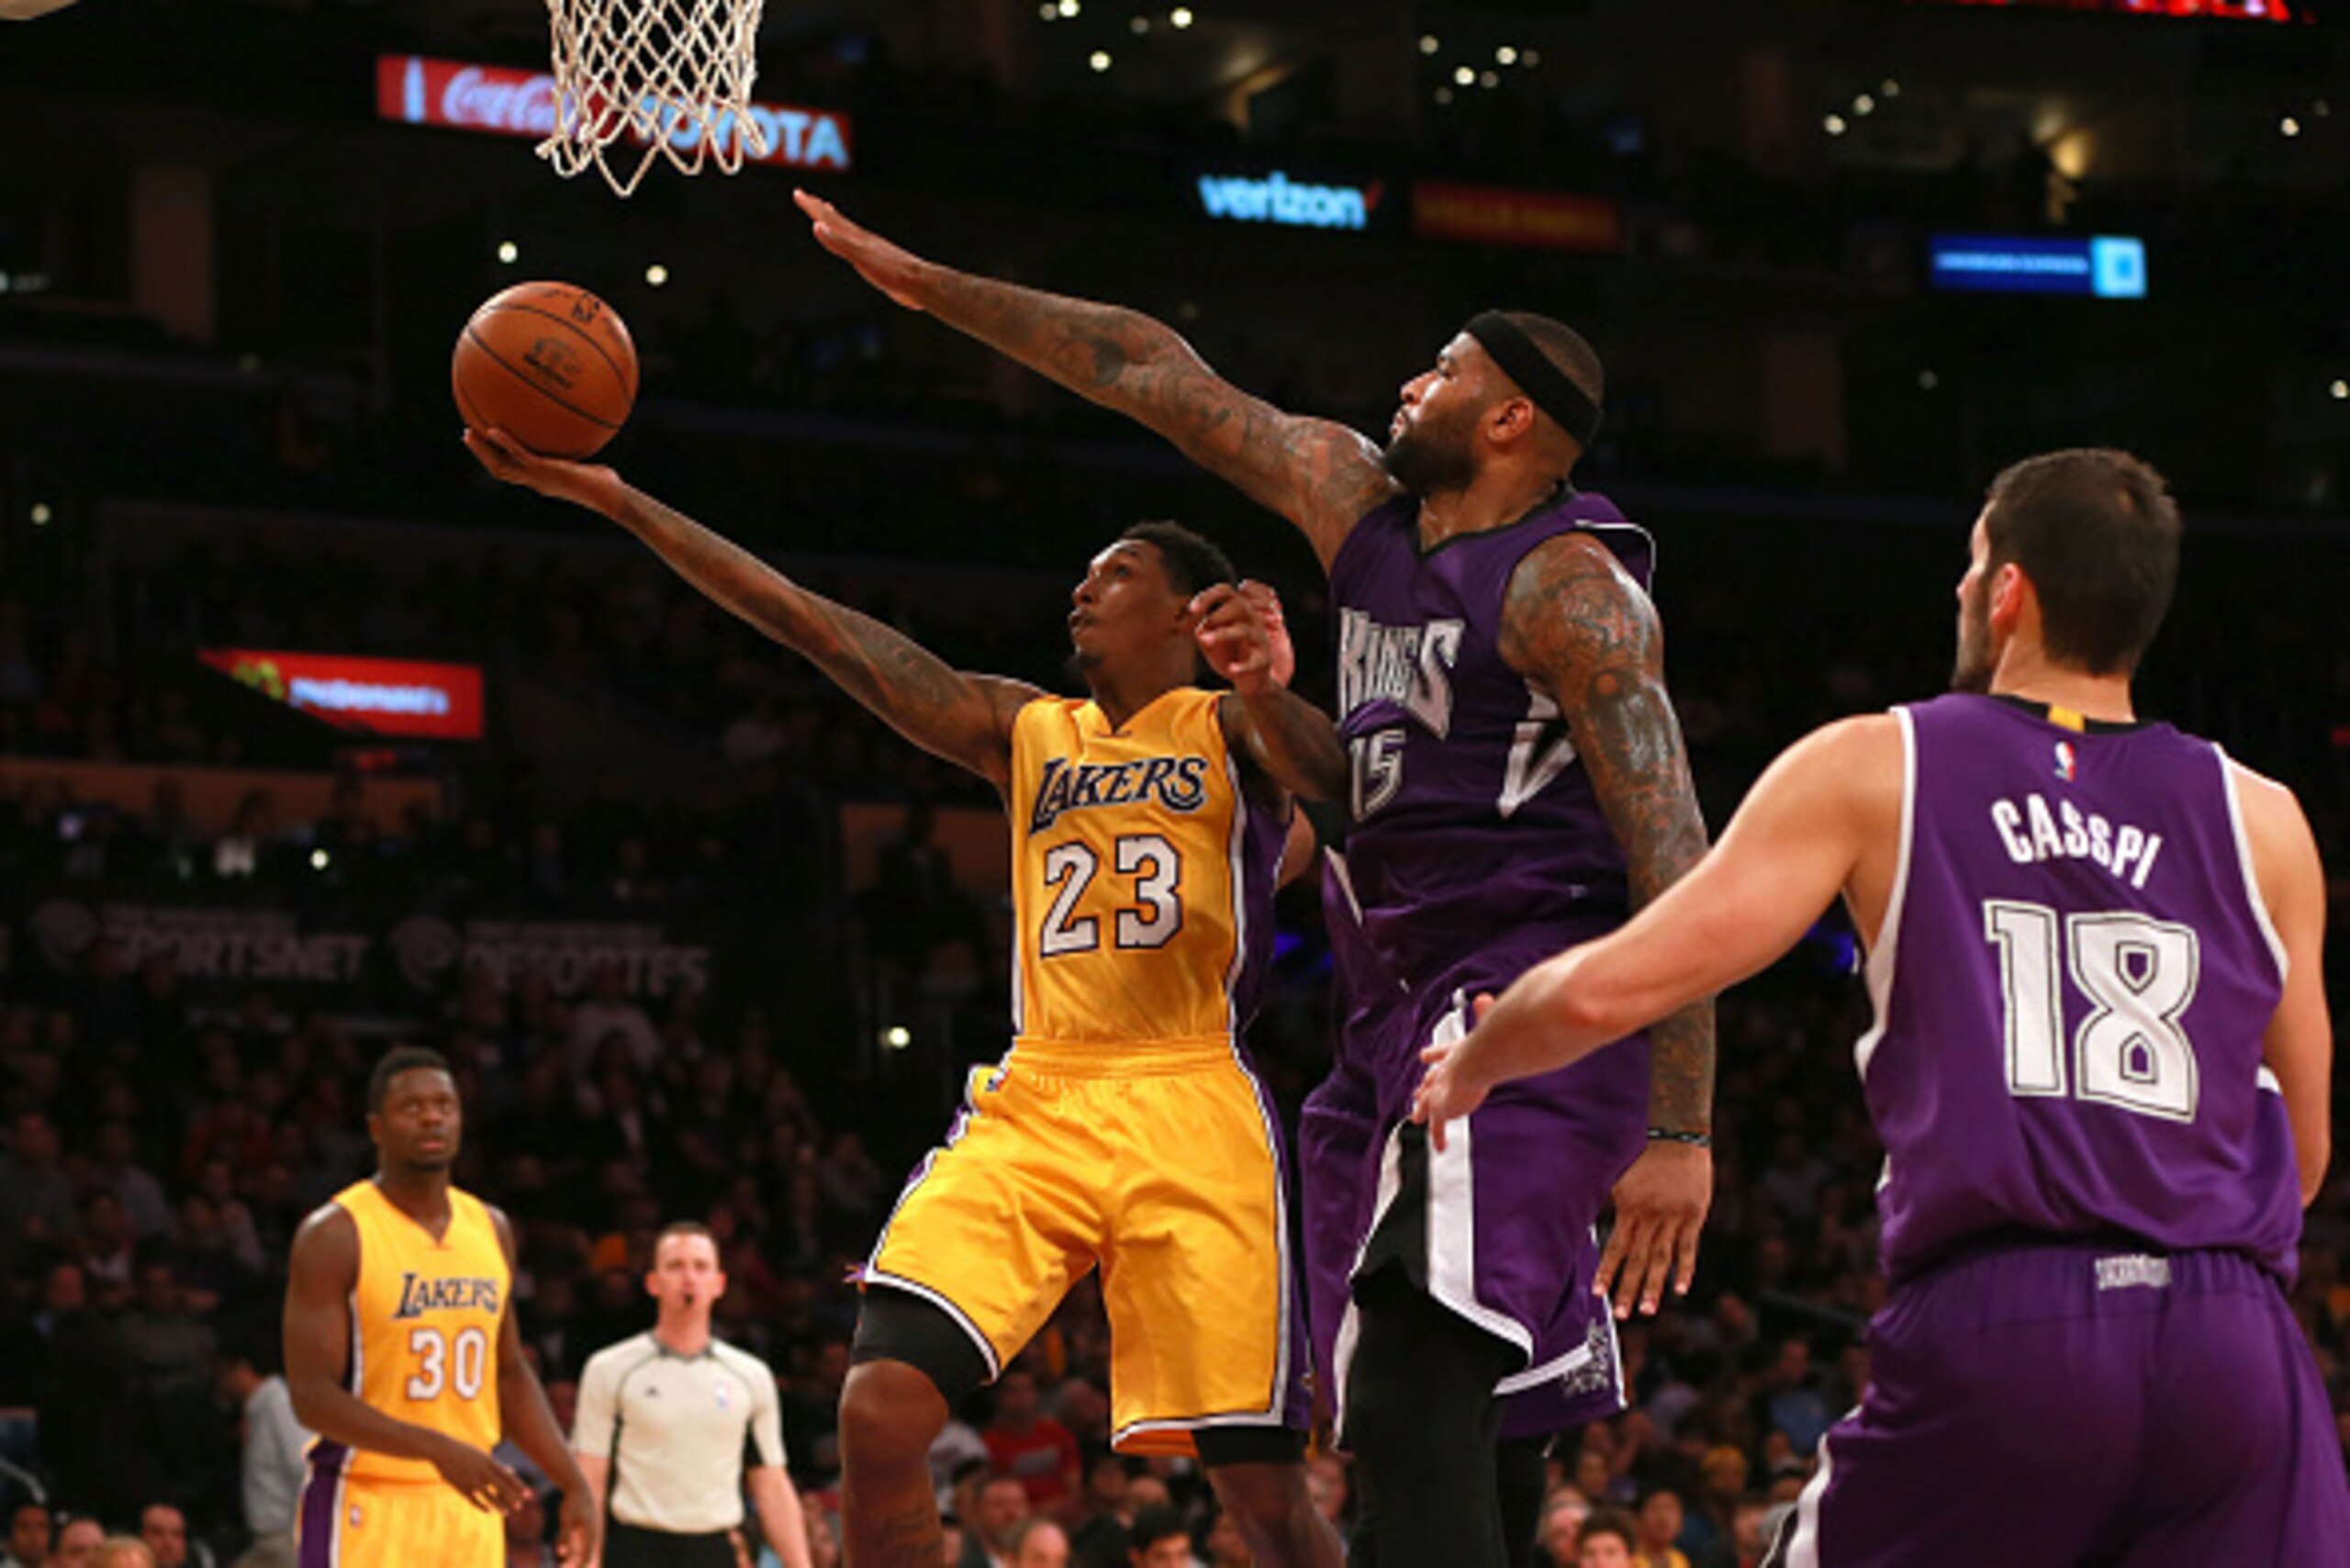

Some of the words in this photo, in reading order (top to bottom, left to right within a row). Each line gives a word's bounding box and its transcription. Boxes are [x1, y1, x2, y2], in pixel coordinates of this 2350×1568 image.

[632, 94, 849, 168] TOYOTA
[1199, 171, 1367, 229] verizon
[1338, 606, 1465, 740] KINGS
[1028, 756, 1208, 836] LAKERS
[1349, 729, 1406, 823] 15
[1990, 793, 2163, 889] CASSPI
[1040, 834, 1182, 958] 23
[1983, 900, 2200, 1125] 18
[392, 1271, 498, 1320] LAKERS
[407, 1326, 487, 1402] 30
